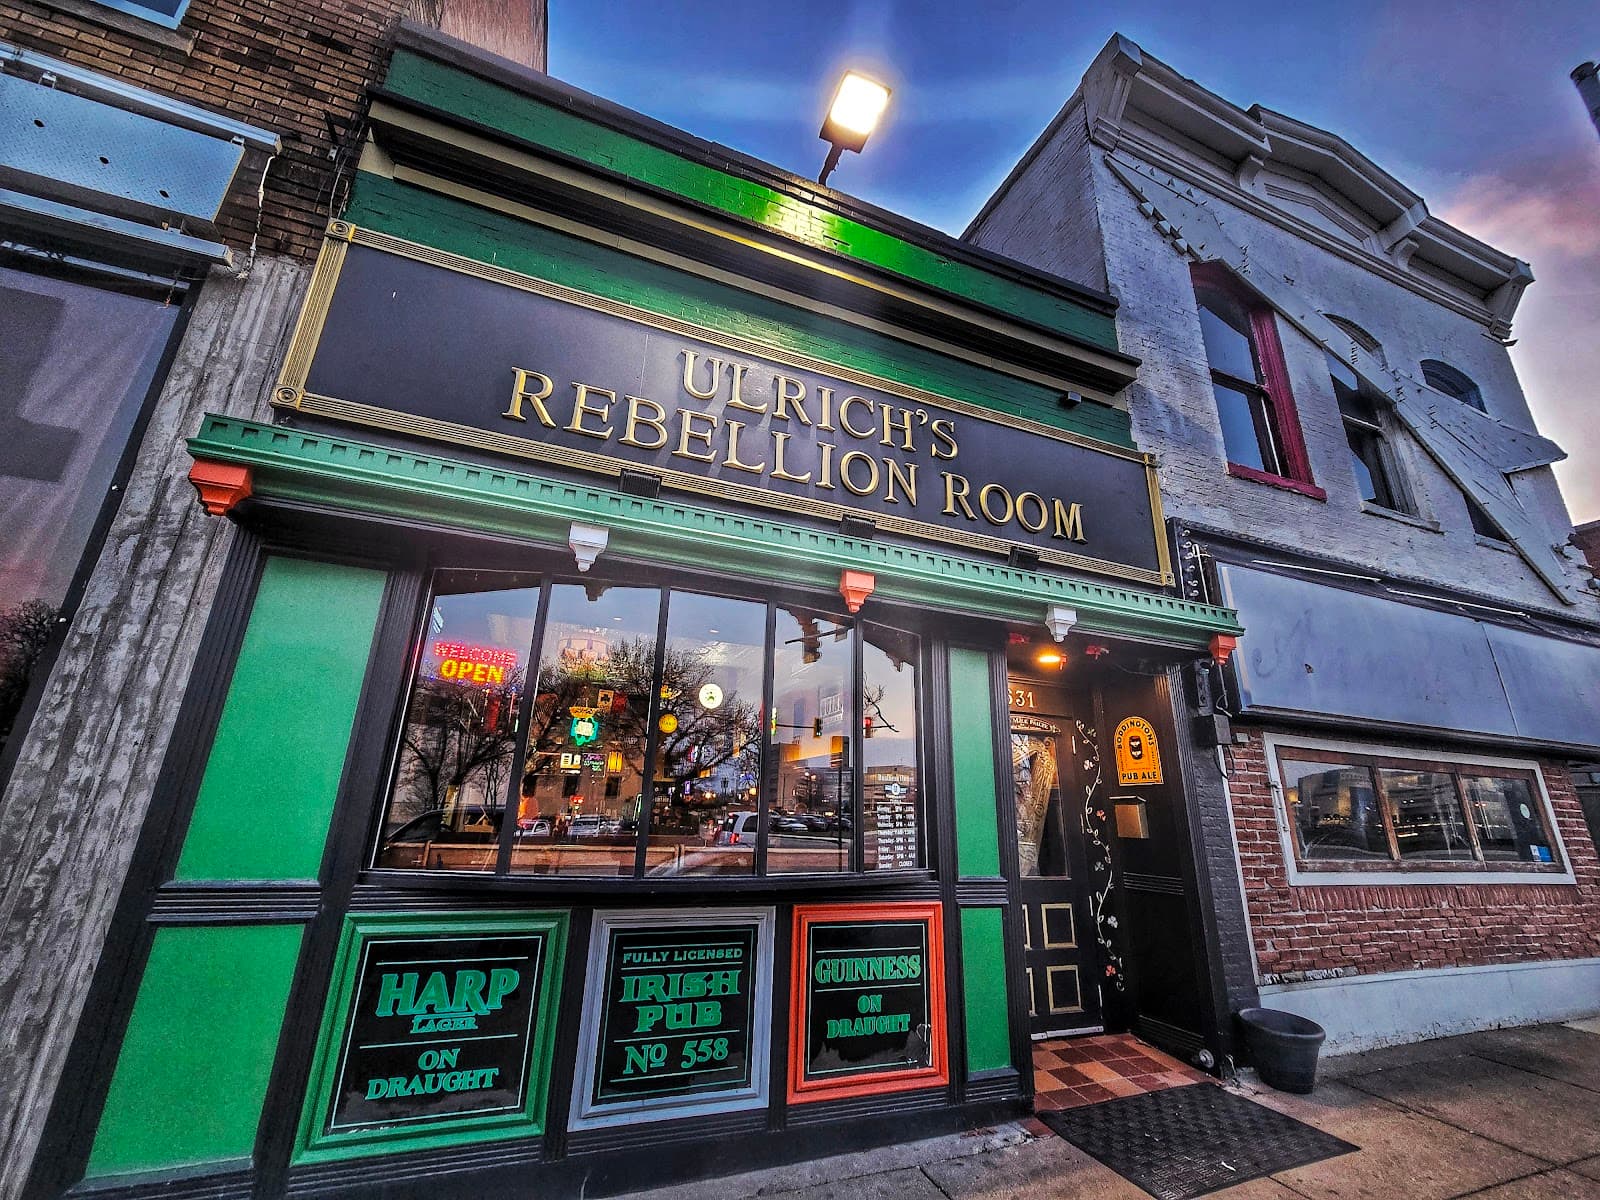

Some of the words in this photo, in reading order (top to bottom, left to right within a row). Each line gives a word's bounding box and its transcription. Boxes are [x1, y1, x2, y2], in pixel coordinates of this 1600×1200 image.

[502, 366, 919, 505] REBELLION
[940, 471, 1088, 543] ROOM
[434, 642, 517, 666] WELCOME
[440, 659, 504, 683] OPEN
[1122, 772, 1138, 780] PUB
[1141, 771, 1157, 779] ALE
[622, 950, 670, 964] FULLY
[673, 947, 744, 962] LICENSED
[814, 953, 922, 984] GUINNESS
[376, 966, 519, 1018] HARP
[622, 968, 741, 1004] IRISH
[637, 1001, 723, 1033] PUB
[856, 994, 883, 1014] ON
[410, 1015, 478, 1034] LAGER
[826, 1014, 911, 1040] DRAUGHT
[417, 1048, 461, 1071] ON
[681, 1039, 730, 1069] 558
[364, 1067, 500, 1101] DRAUGHT
